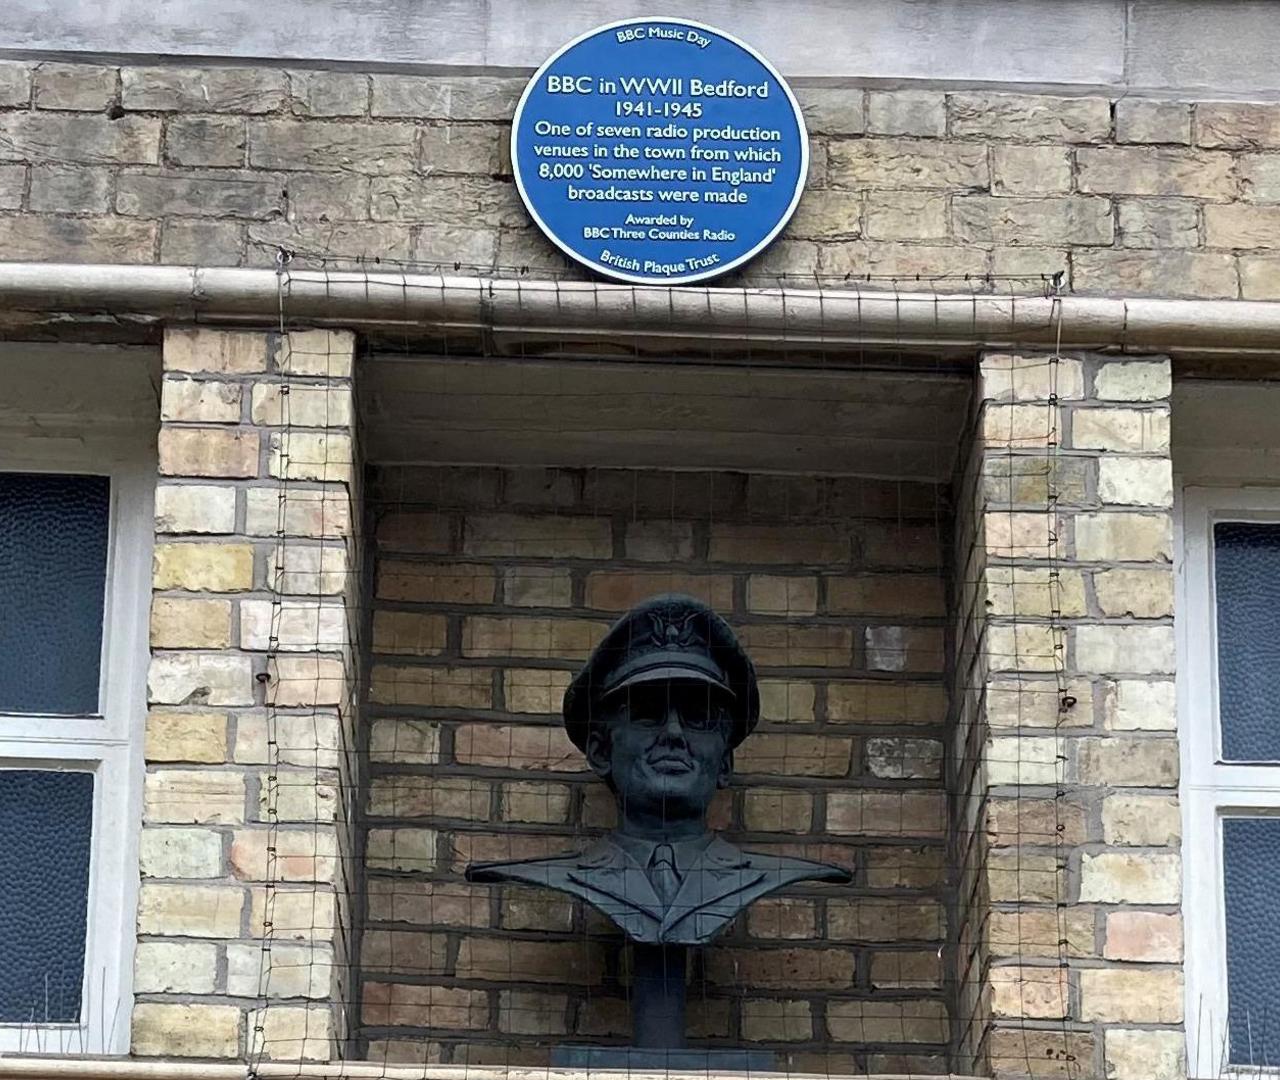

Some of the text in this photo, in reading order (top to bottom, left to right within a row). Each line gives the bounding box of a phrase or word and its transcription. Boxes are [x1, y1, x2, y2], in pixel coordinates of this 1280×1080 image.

[616, 27, 711, 47] BBC Music Day
[548, 76, 768, 98] BBC in WWII Bedford
[616, 102, 702, 117] 1941-1945
[535, 122, 780, 142] One of seven radio production
[534, 144, 780, 161] venues in the town from which
[539, 164, 776, 185] 8,000 'Somewhere in England'
[568, 185, 747, 202] broadcasts were made
[625, 215, 694, 228] Awarded by
[584, 228, 735, 241] BBC Three Counties Radio
[600, 250, 720, 276] British Plaque Trust
